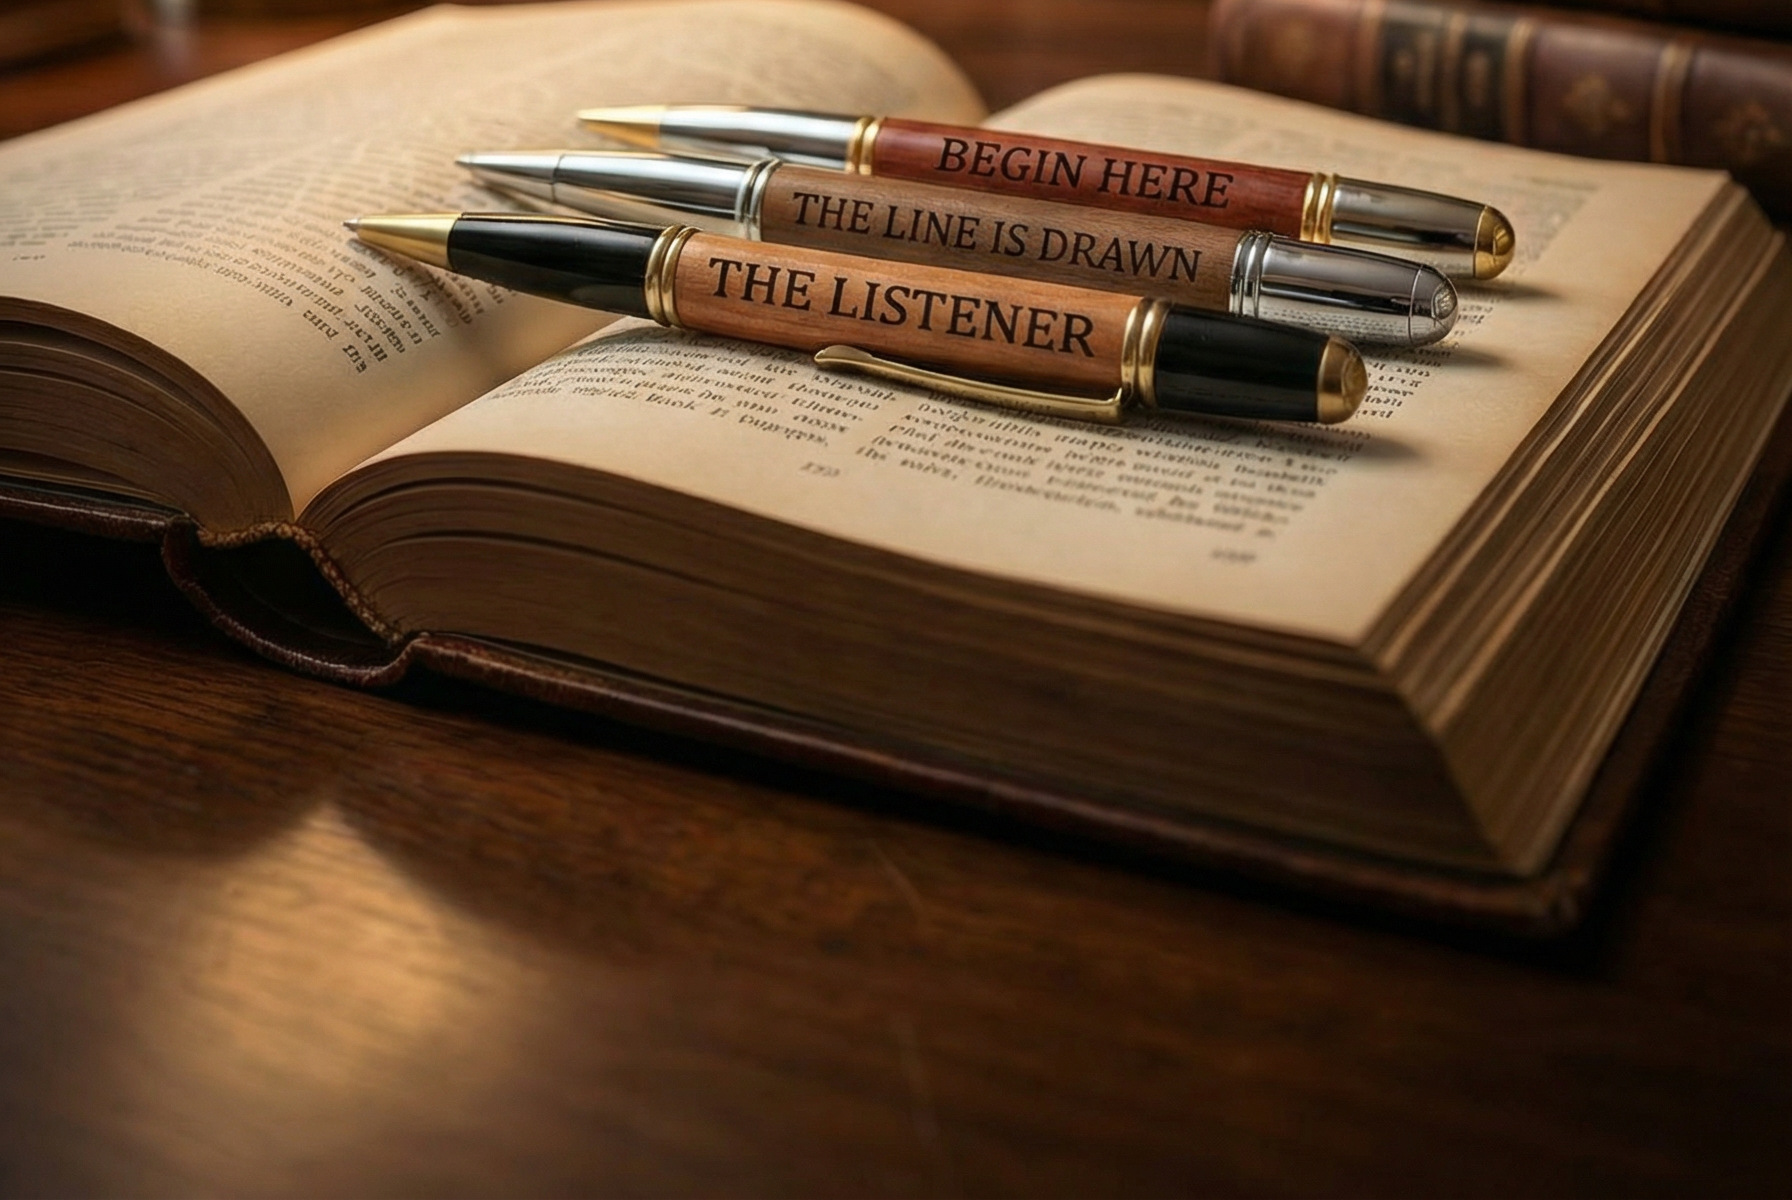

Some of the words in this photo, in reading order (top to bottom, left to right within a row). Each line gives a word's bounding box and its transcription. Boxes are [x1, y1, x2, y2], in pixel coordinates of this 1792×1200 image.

[936, 137, 1087, 189] BEGIN
[1099, 157, 1235, 210] HERE
[792, 191, 874, 234] THE
[882, 205, 981, 252] LINE
[990, 221, 1029, 257] IS
[1040, 228, 1202, 284] DRAWN
[708, 257, 816, 311] THE
[827, 276, 1095, 358] LISTENER
